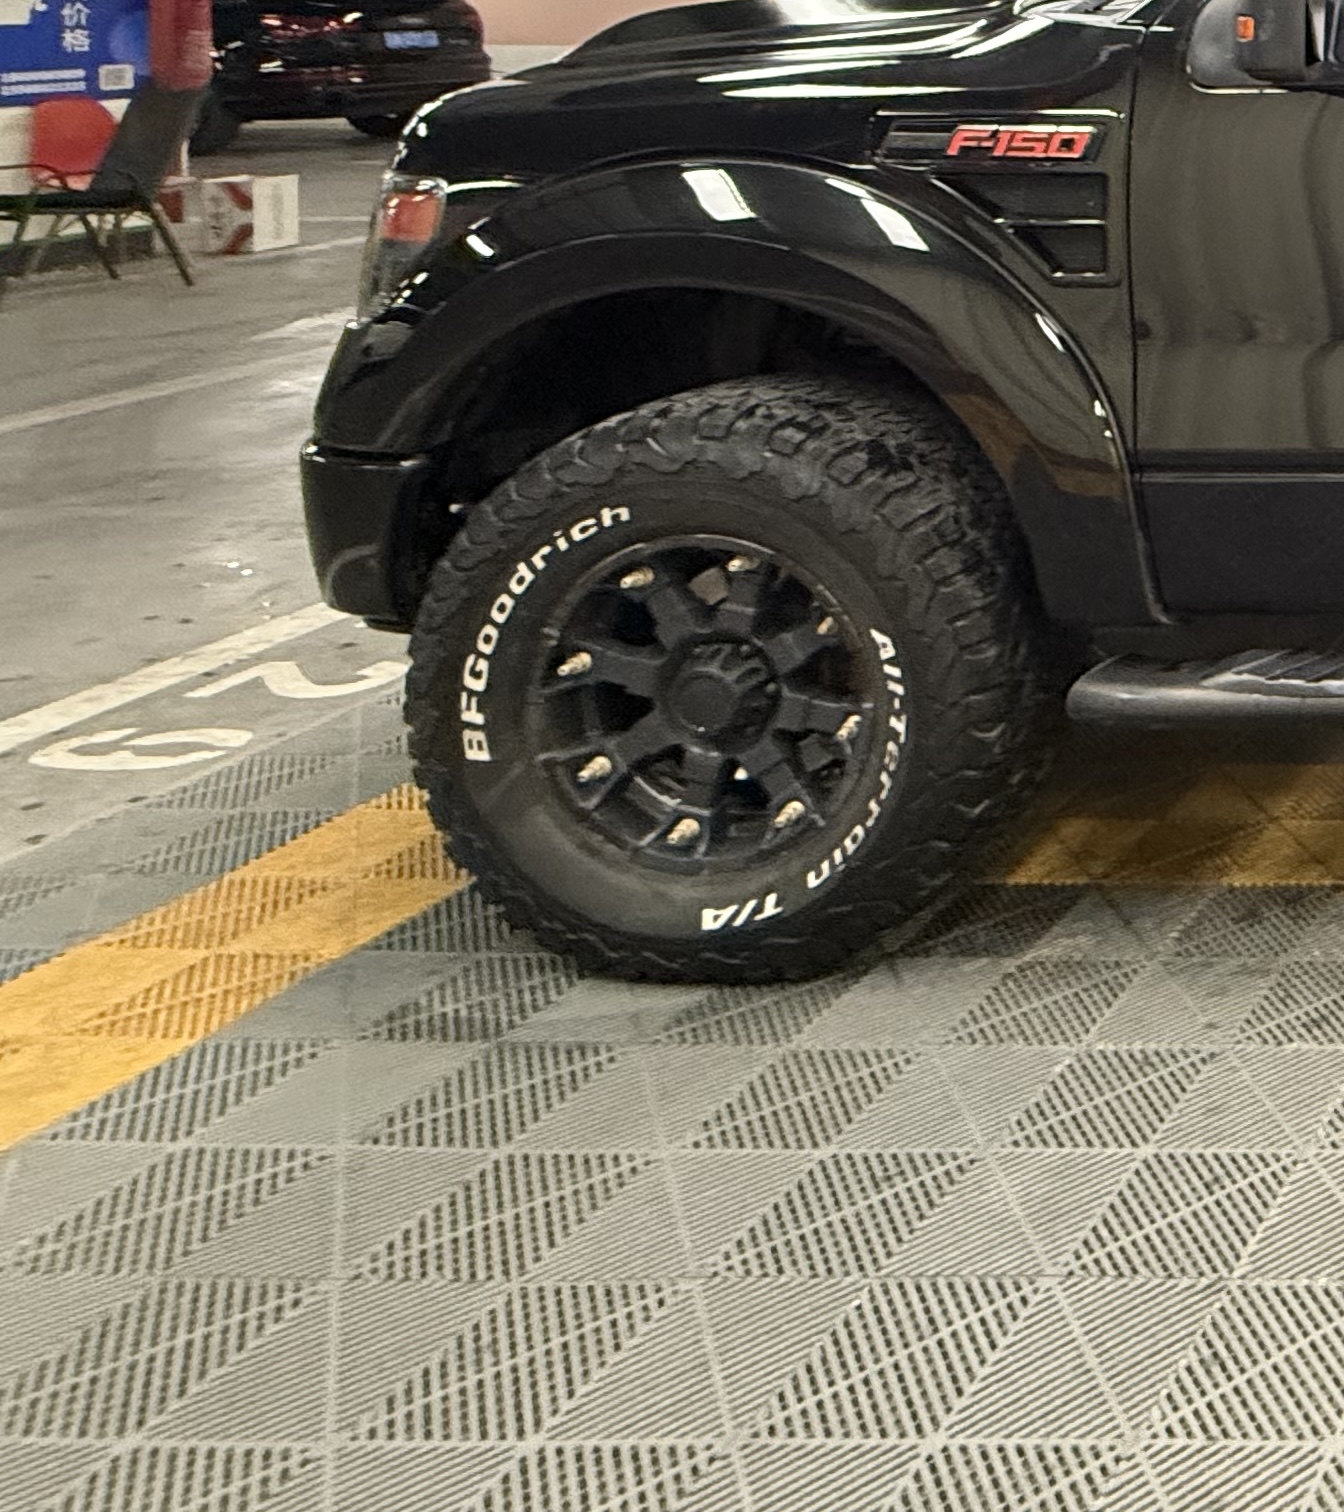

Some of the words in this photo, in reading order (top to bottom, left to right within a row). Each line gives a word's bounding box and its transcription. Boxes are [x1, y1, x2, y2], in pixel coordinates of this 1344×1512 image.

[946, 124, 1097, 159] F-150
[460, 504, 631, 762] BFGoodrich
[700, 893, 784, 930] T/A
